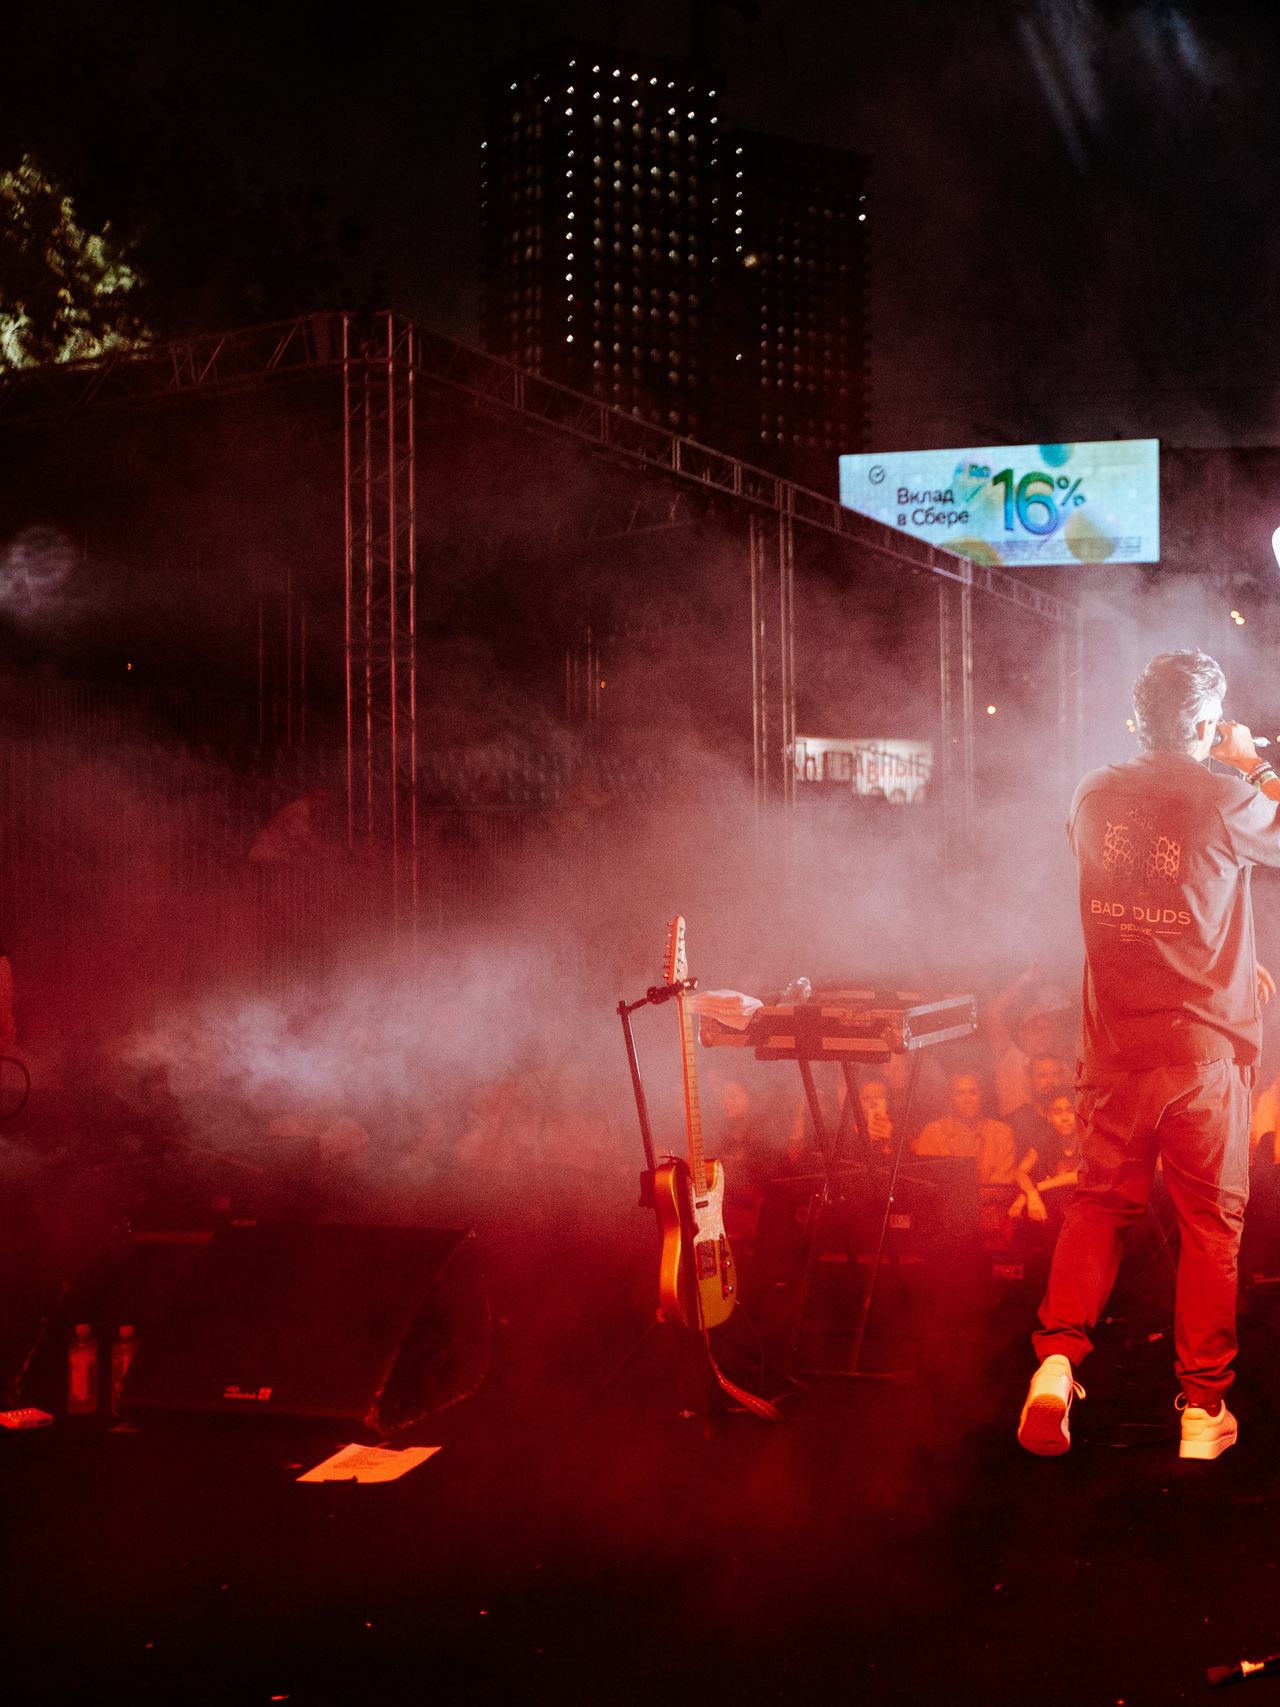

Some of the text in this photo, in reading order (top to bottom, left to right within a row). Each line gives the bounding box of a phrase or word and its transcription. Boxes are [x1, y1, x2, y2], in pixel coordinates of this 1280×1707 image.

[897, 487, 954, 505] Вклад
[992, 468, 1086, 536] 16%
[897, 508, 969, 529] в Сбере
[1091, 900, 1191, 925] BAD DUDS
